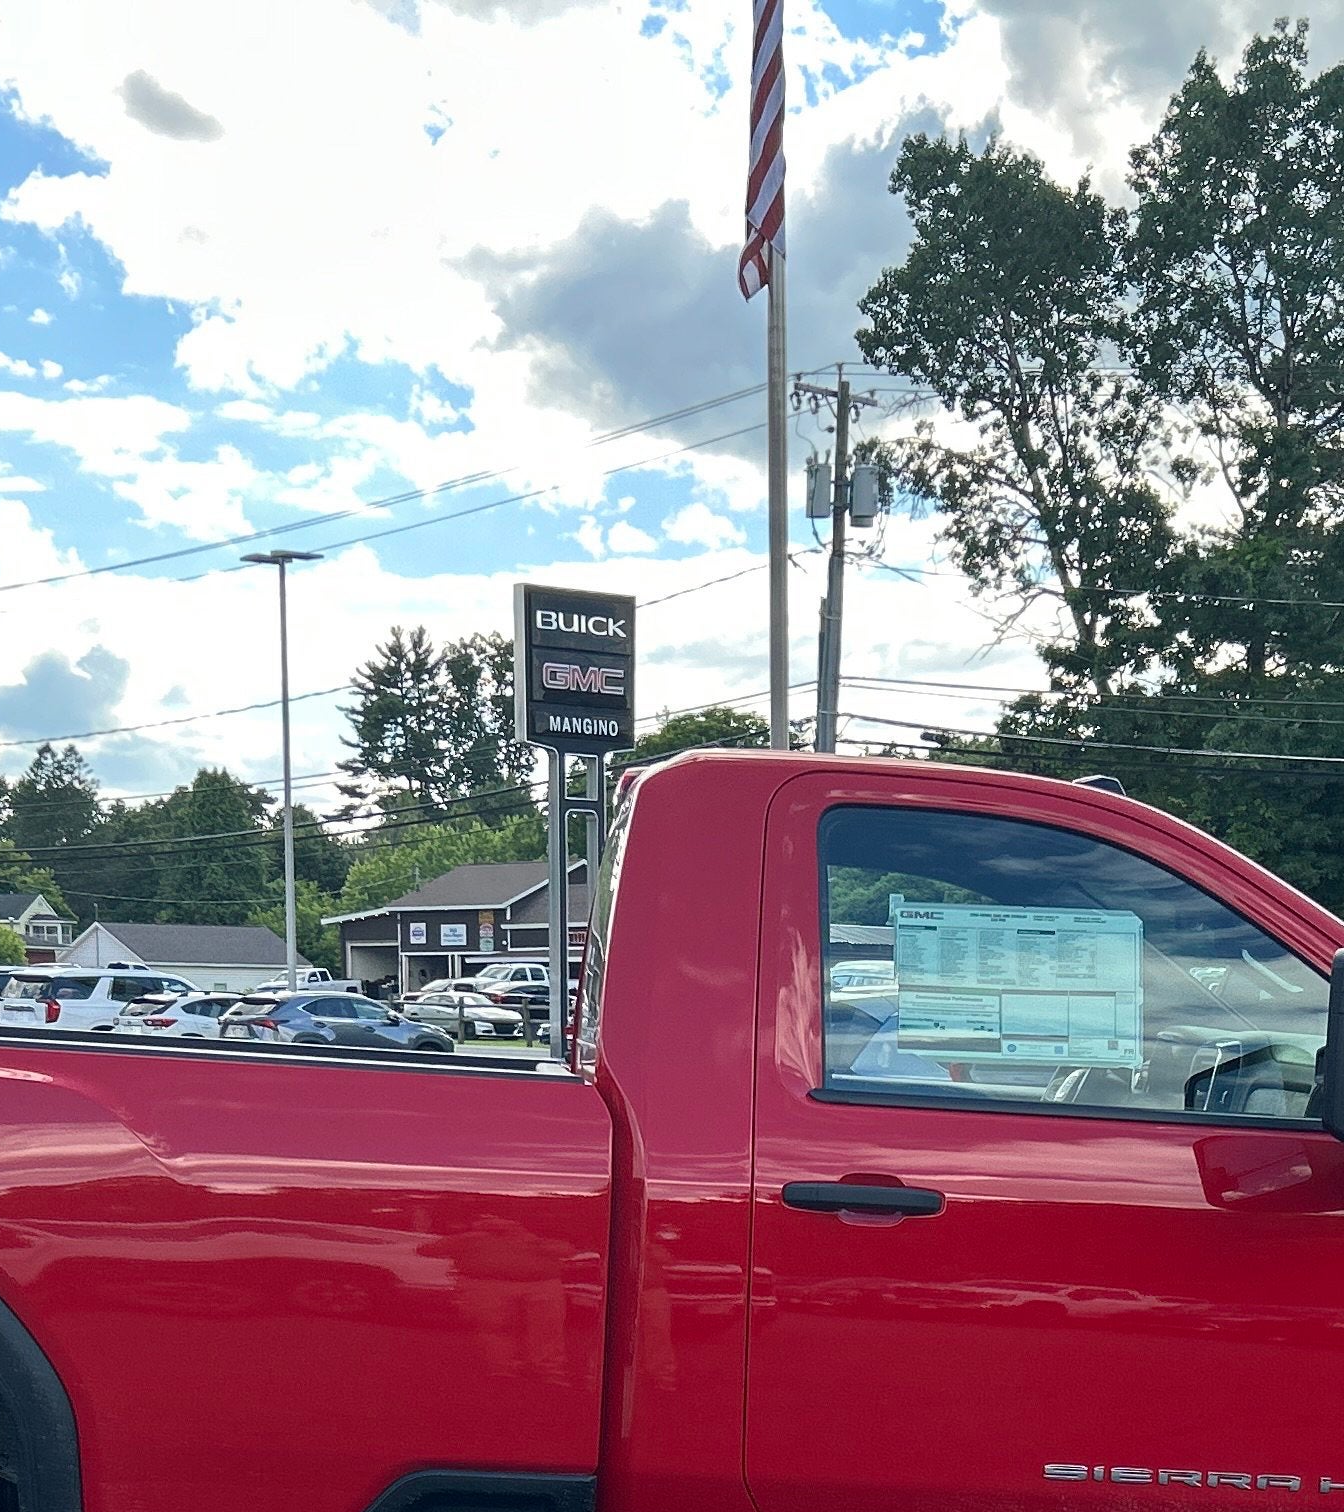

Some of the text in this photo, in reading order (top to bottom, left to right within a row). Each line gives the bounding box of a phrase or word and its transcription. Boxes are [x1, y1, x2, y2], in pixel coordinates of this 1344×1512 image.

[535, 609, 627, 638] BUICK
[542, 662, 625, 696] GMC
[549, 715, 619, 737] MANGINO
[899, 910, 945, 920] GMC
[1042, 1463, 1302, 1492] SIERRA
